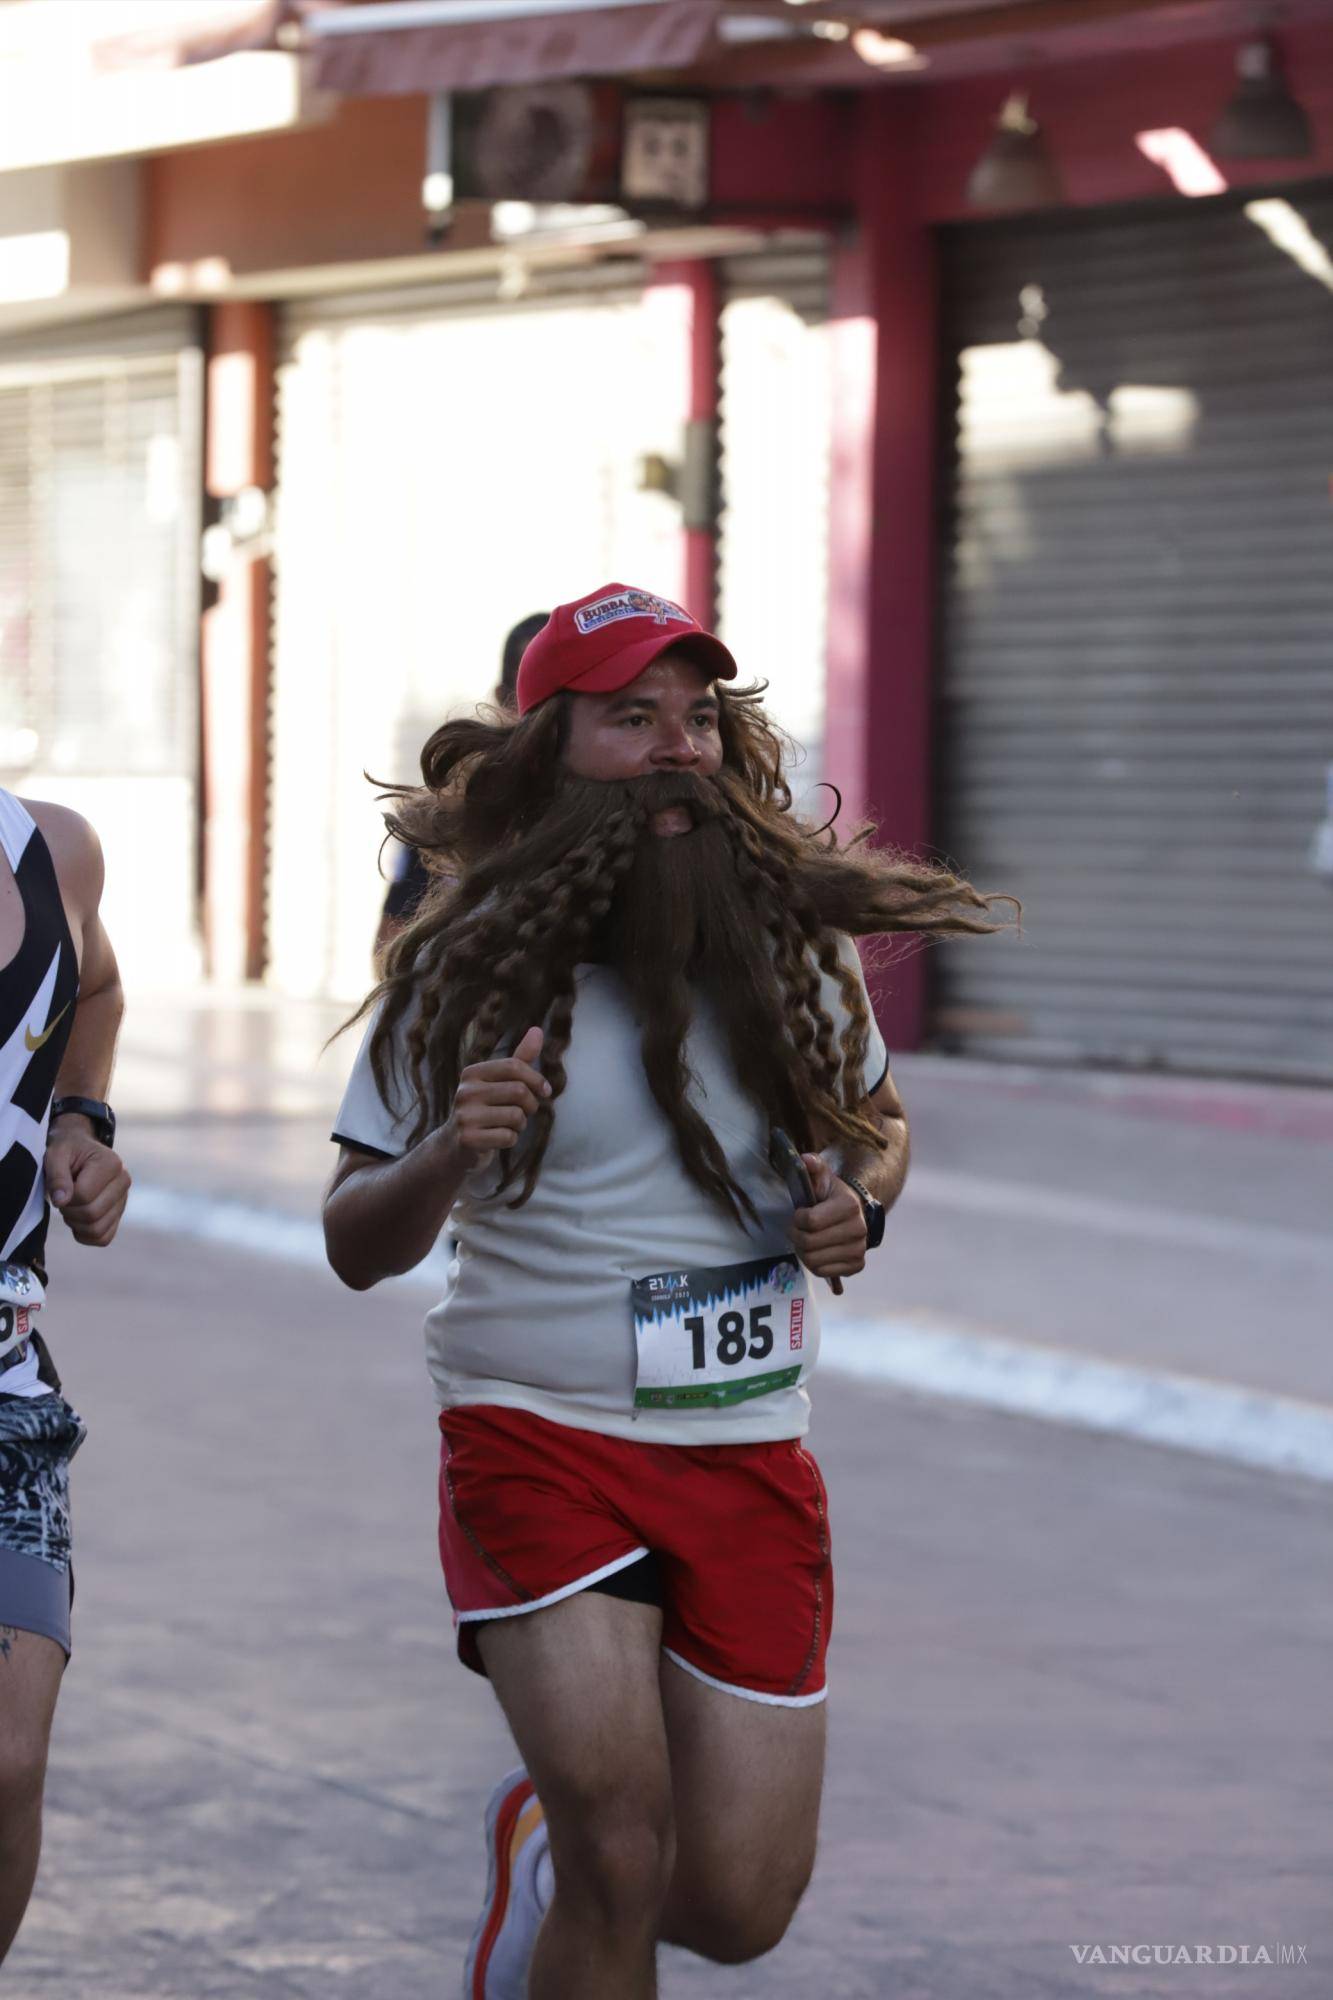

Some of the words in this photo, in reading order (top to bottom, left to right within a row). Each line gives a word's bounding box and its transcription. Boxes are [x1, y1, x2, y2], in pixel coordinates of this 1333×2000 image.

[649, 1277, 664, 1291] 21
[680, 1274, 689, 1288] K
[684, 1304, 774, 1369] 185
[791, 1299, 803, 1349] SALTILLO
